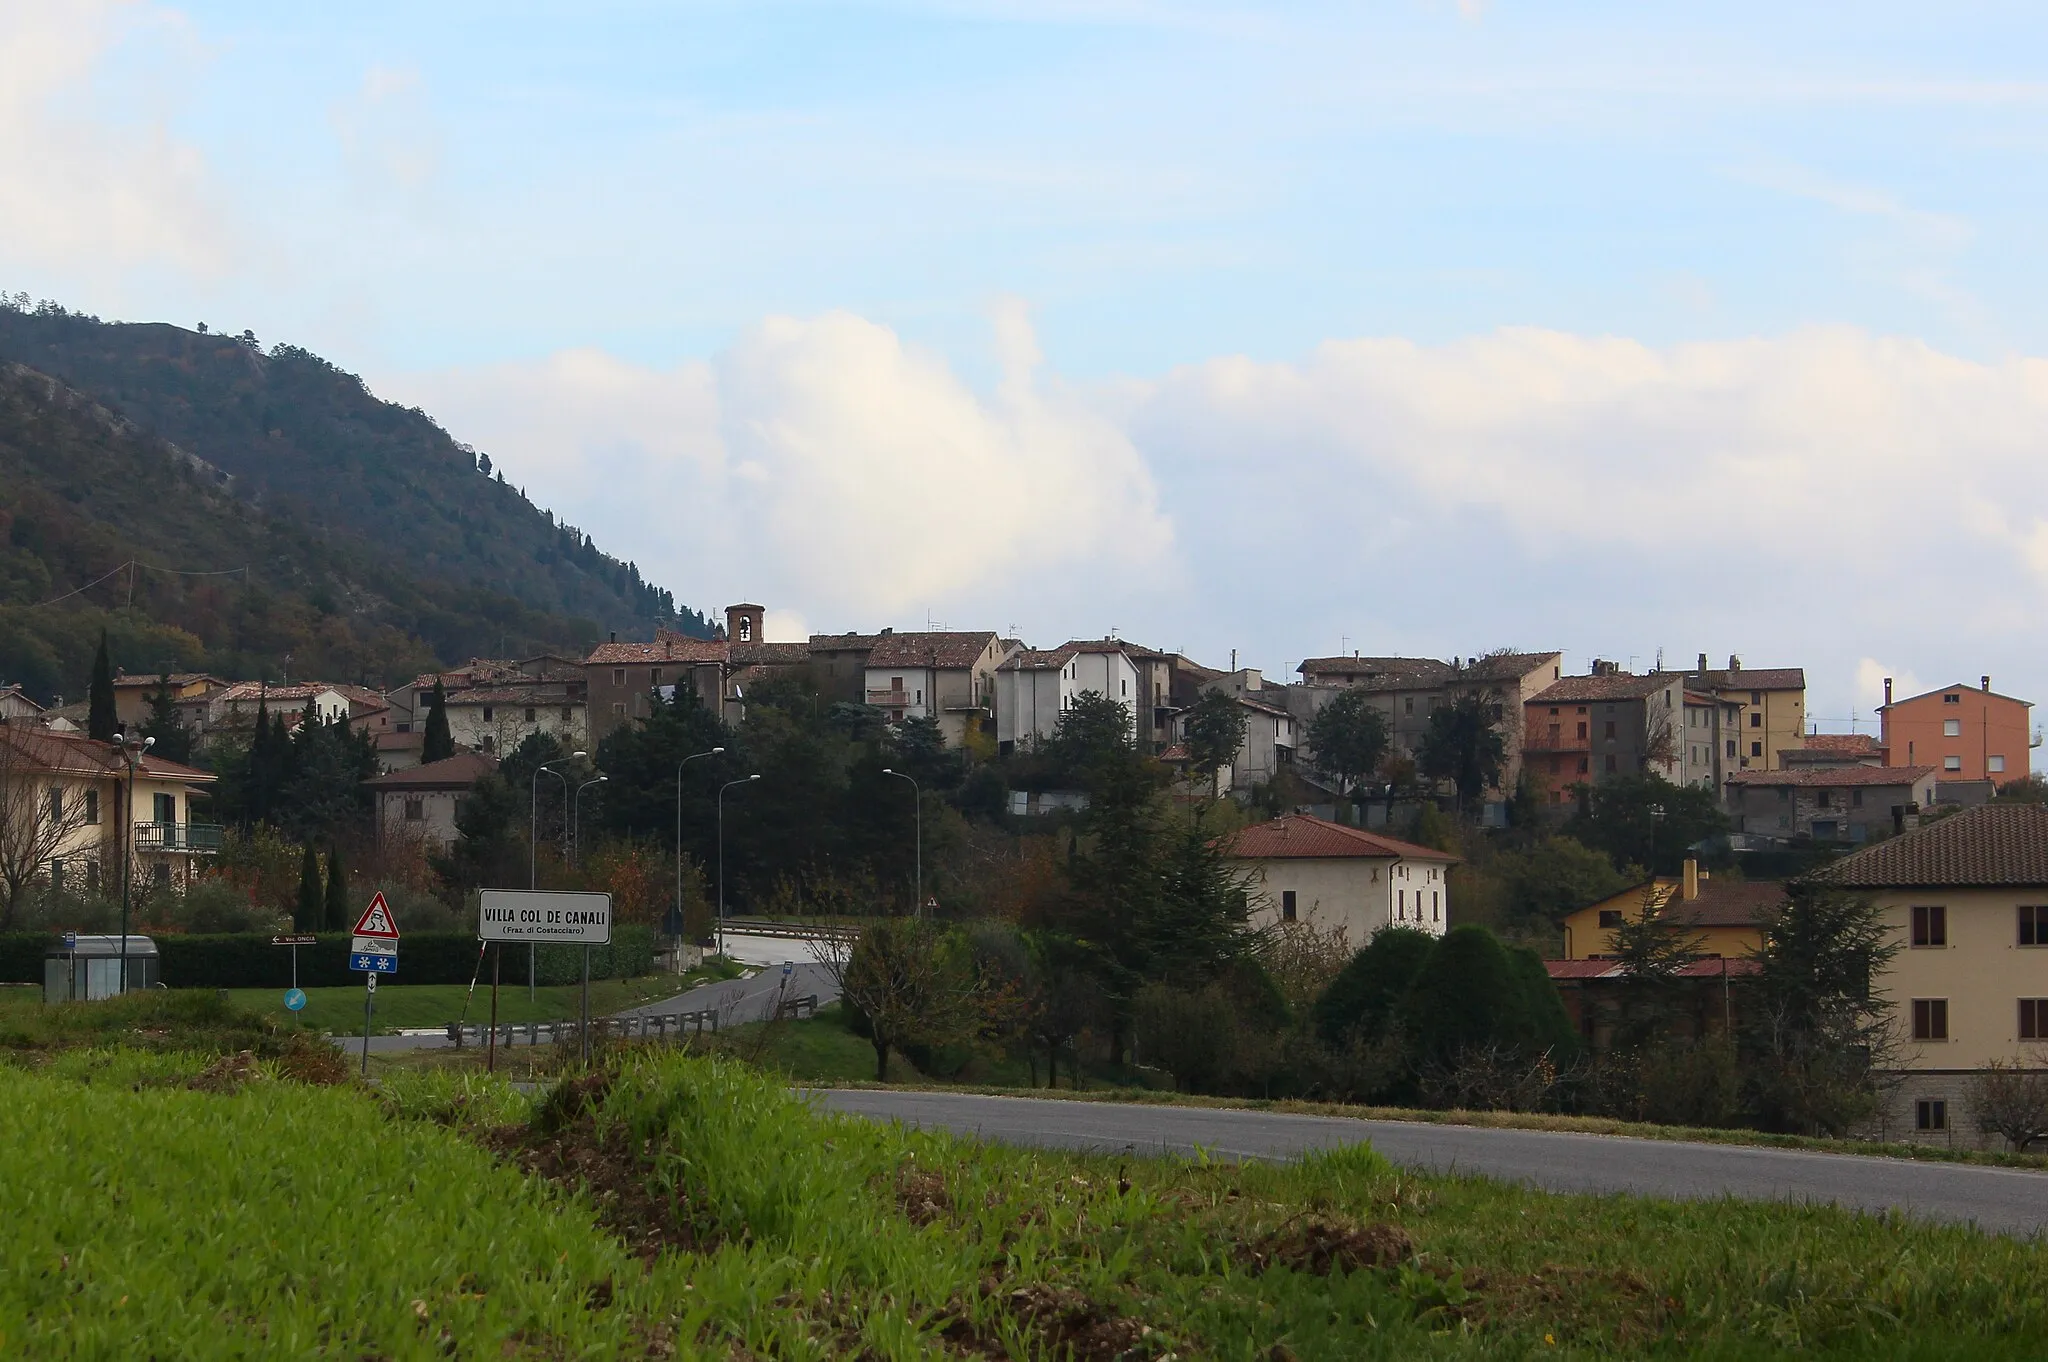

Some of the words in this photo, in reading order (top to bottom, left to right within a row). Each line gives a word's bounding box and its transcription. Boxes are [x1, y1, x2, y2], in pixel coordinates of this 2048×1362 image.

[485, 909, 515, 922] VILLA
[520, 910, 541, 923] COL
[547, 911, 561, 924] DE
[565, 911, 605, 925] CANALI
[526, 926, 534, 934] di
[536, 926, 585, 935] Costacciaro)
